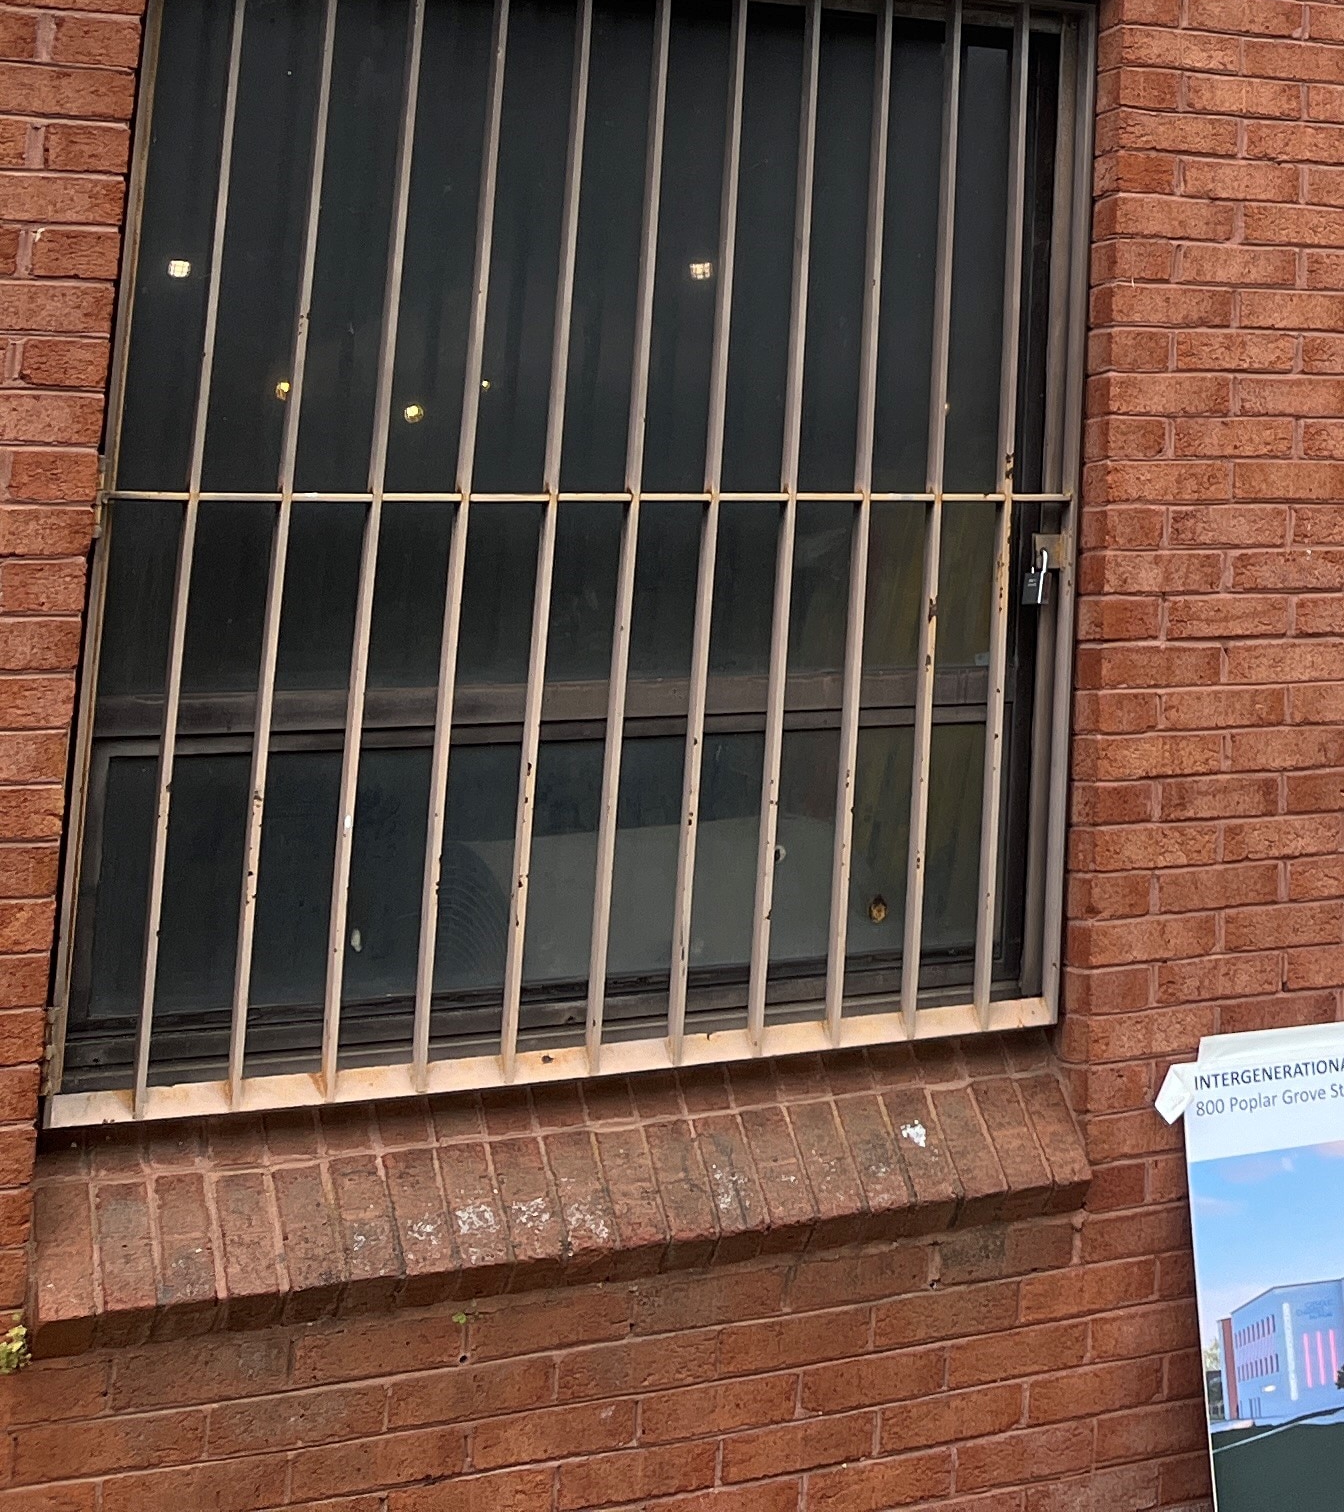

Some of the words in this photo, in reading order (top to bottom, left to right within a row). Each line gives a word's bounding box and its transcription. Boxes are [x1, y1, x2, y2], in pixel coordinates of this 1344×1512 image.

[1196, 1100, 1225, 1117] 800
[1229, 1091, 1277, 1116] Poplar
[1281, 1086, 1326, 1106] Grove
